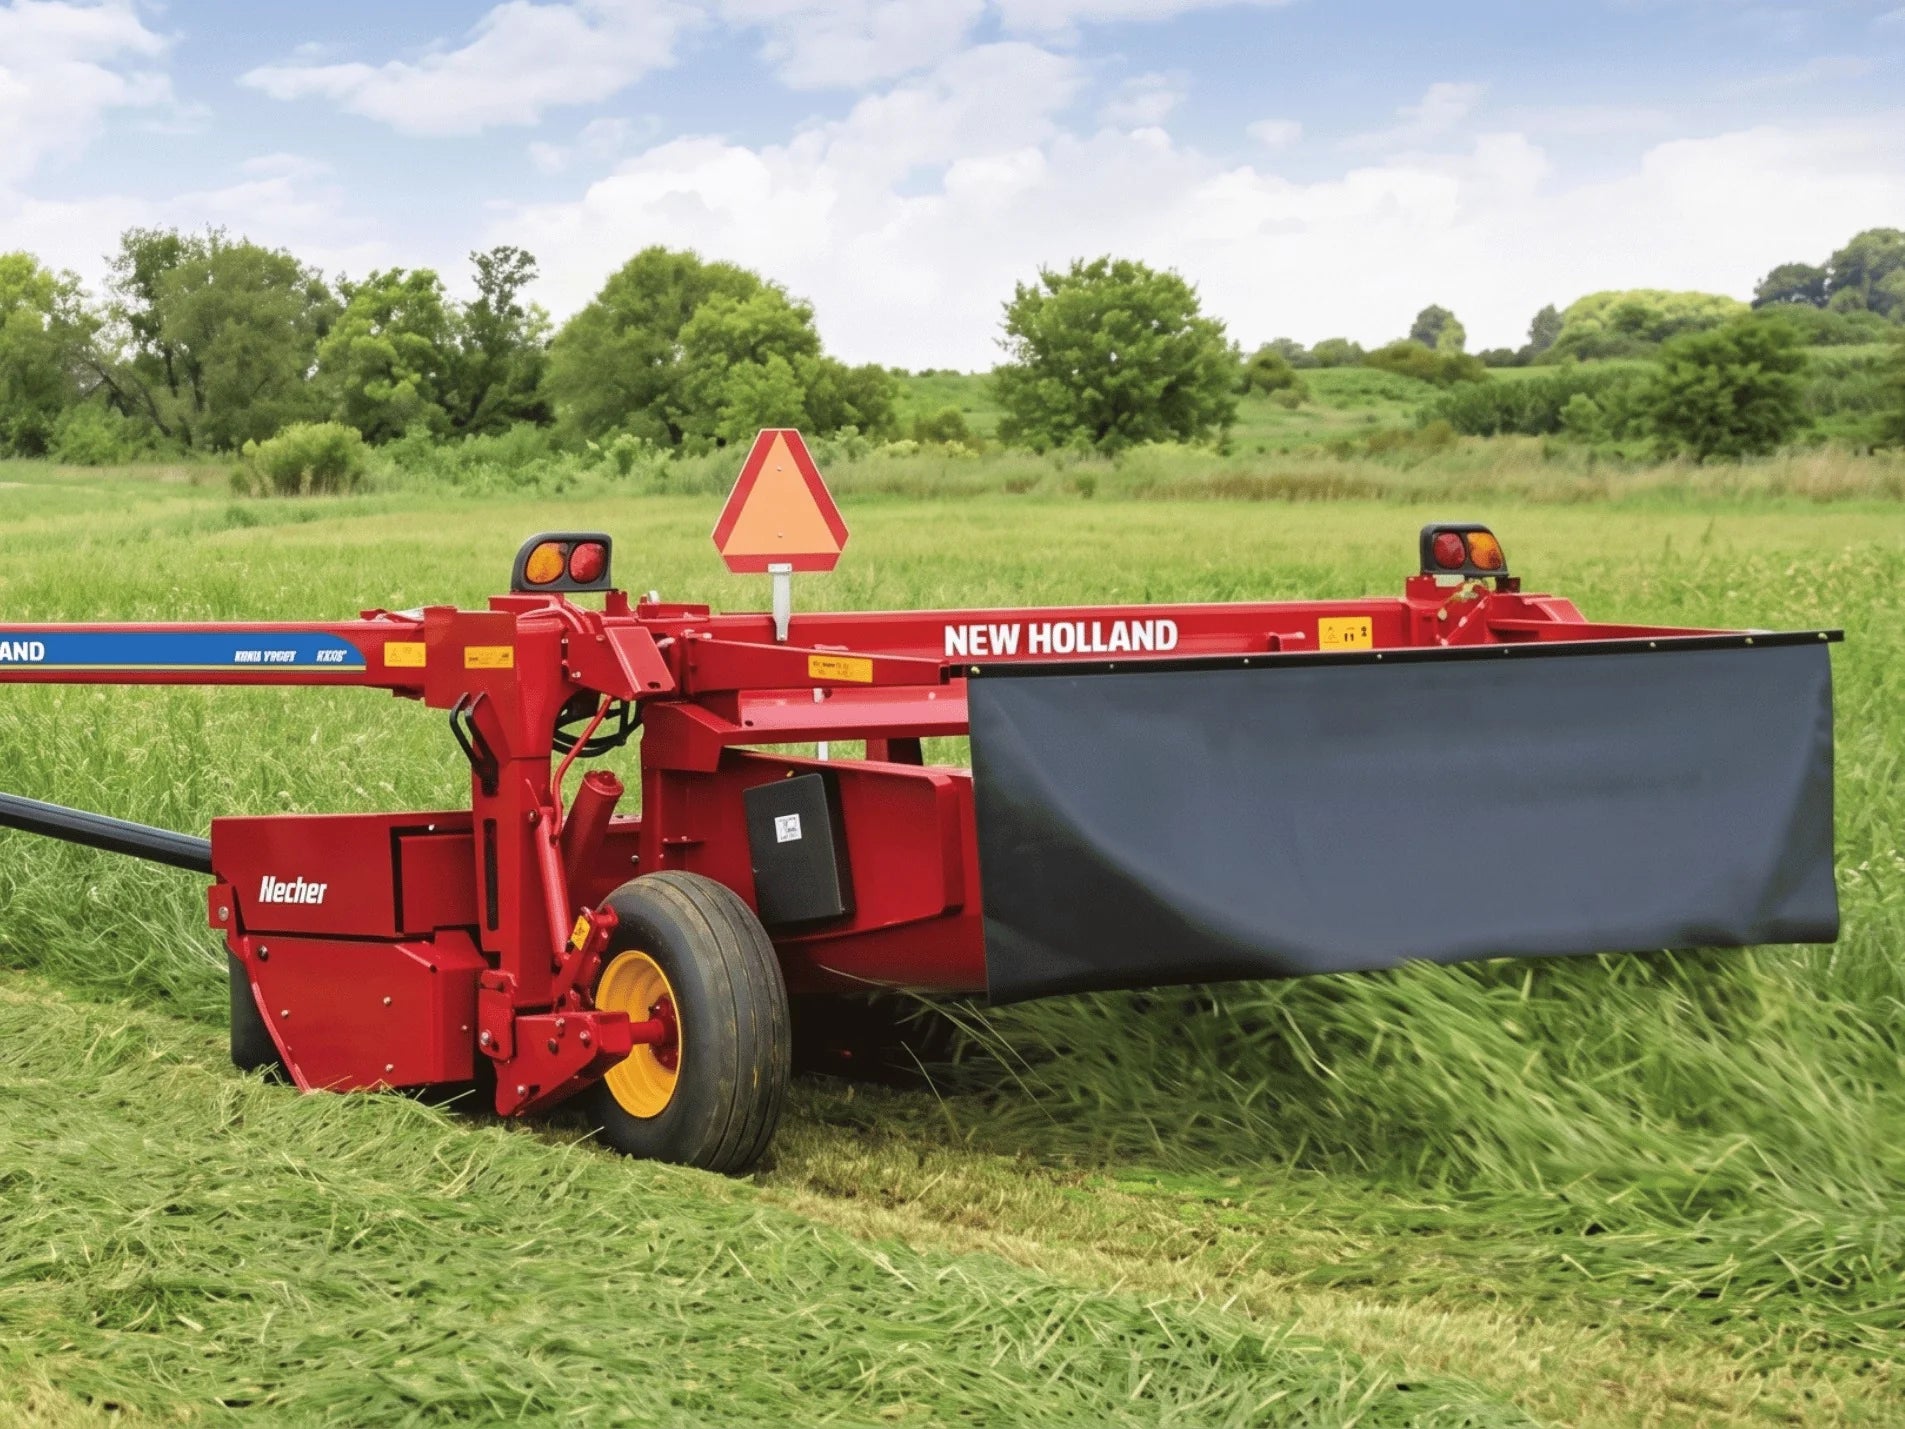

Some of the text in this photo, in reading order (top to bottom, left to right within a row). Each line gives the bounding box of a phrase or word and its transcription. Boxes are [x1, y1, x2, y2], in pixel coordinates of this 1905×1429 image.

[0, 641, 45, 661] AND
[944, 619, 1179, 656] NEW HOLLAND
[258, 875, 328, 904] Necher
